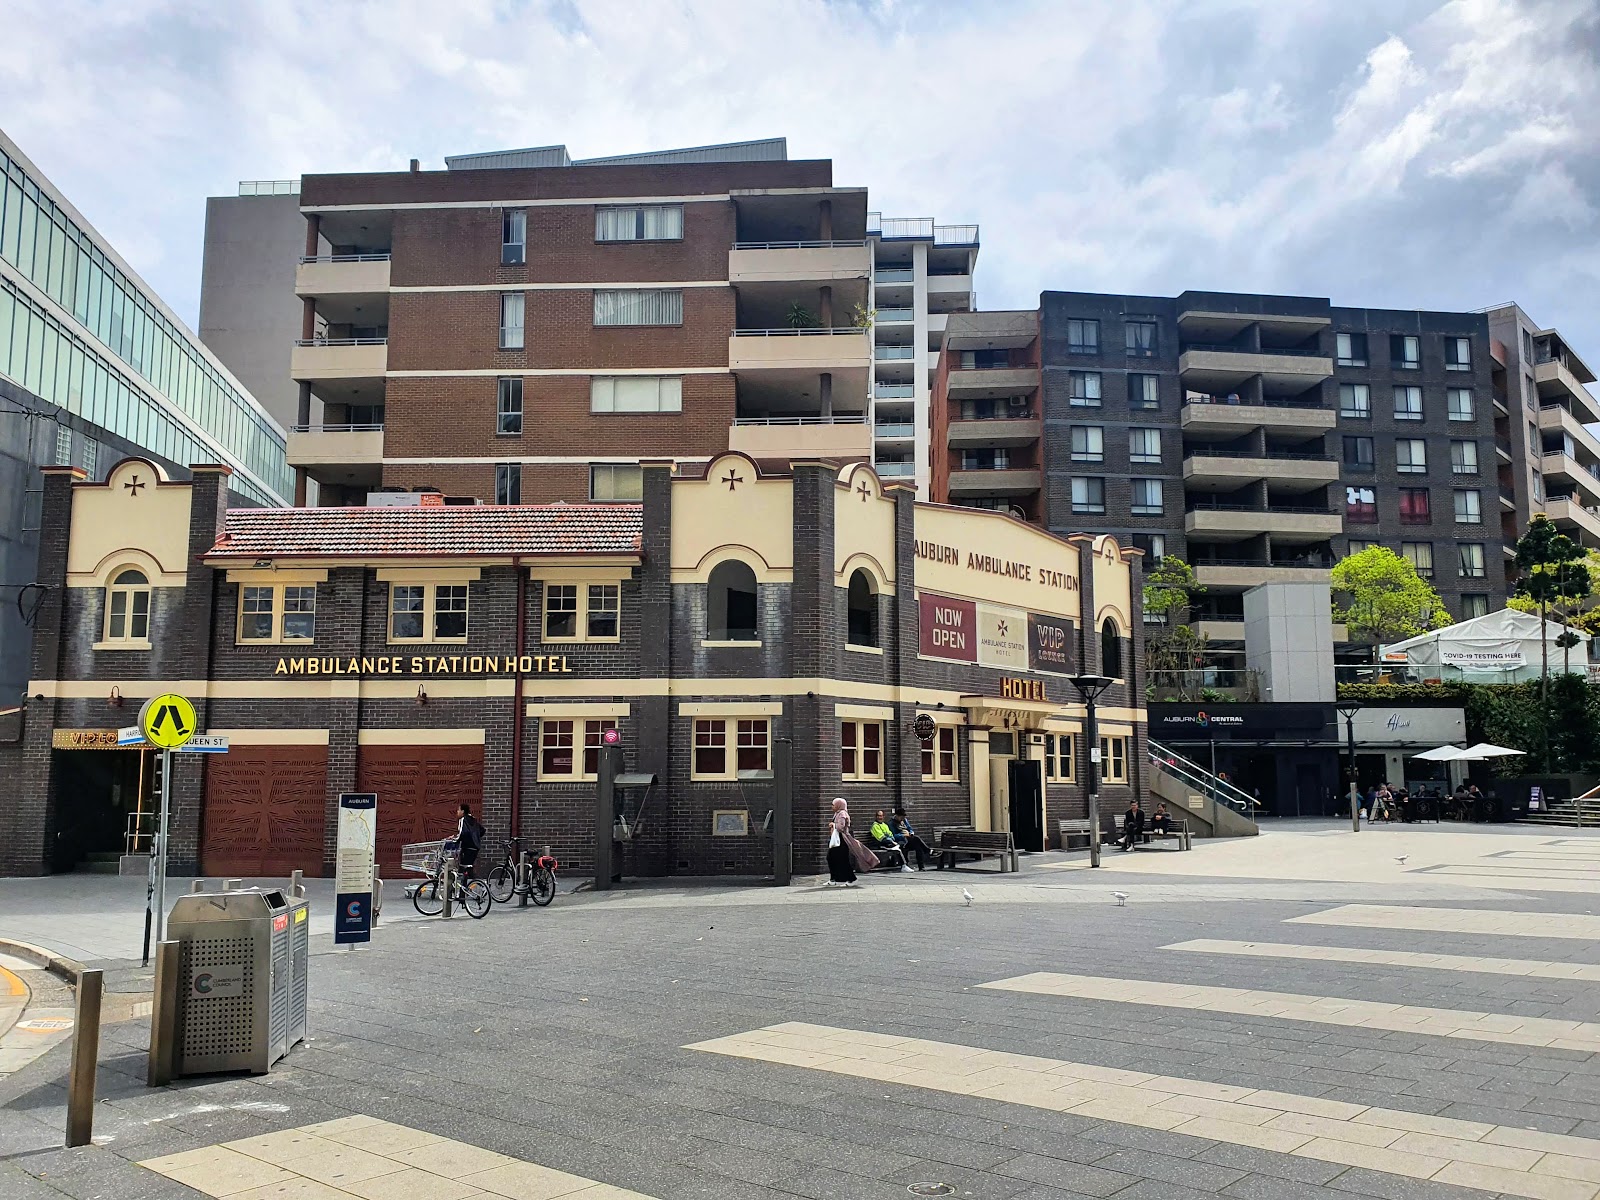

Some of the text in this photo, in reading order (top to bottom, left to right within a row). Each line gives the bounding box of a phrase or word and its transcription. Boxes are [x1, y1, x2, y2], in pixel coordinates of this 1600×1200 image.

[914, 539, 1078, 592] AUBURN AMBULANCE STATION
[935, 606, 963, 627] NOW
[932, 628, 965, 650] OPEN
[981, 638, 1025, 651] AMBULANCE STATION
[1037, 624, 1065, 649] VIP
[275, 656, 572, 675] AMBULANCE STATION HOTEL
[1000, 676, 1047, 701] HOTEL
[71, 732, 118, 744] VIP LO
[212, 738, 224, 746] ST
